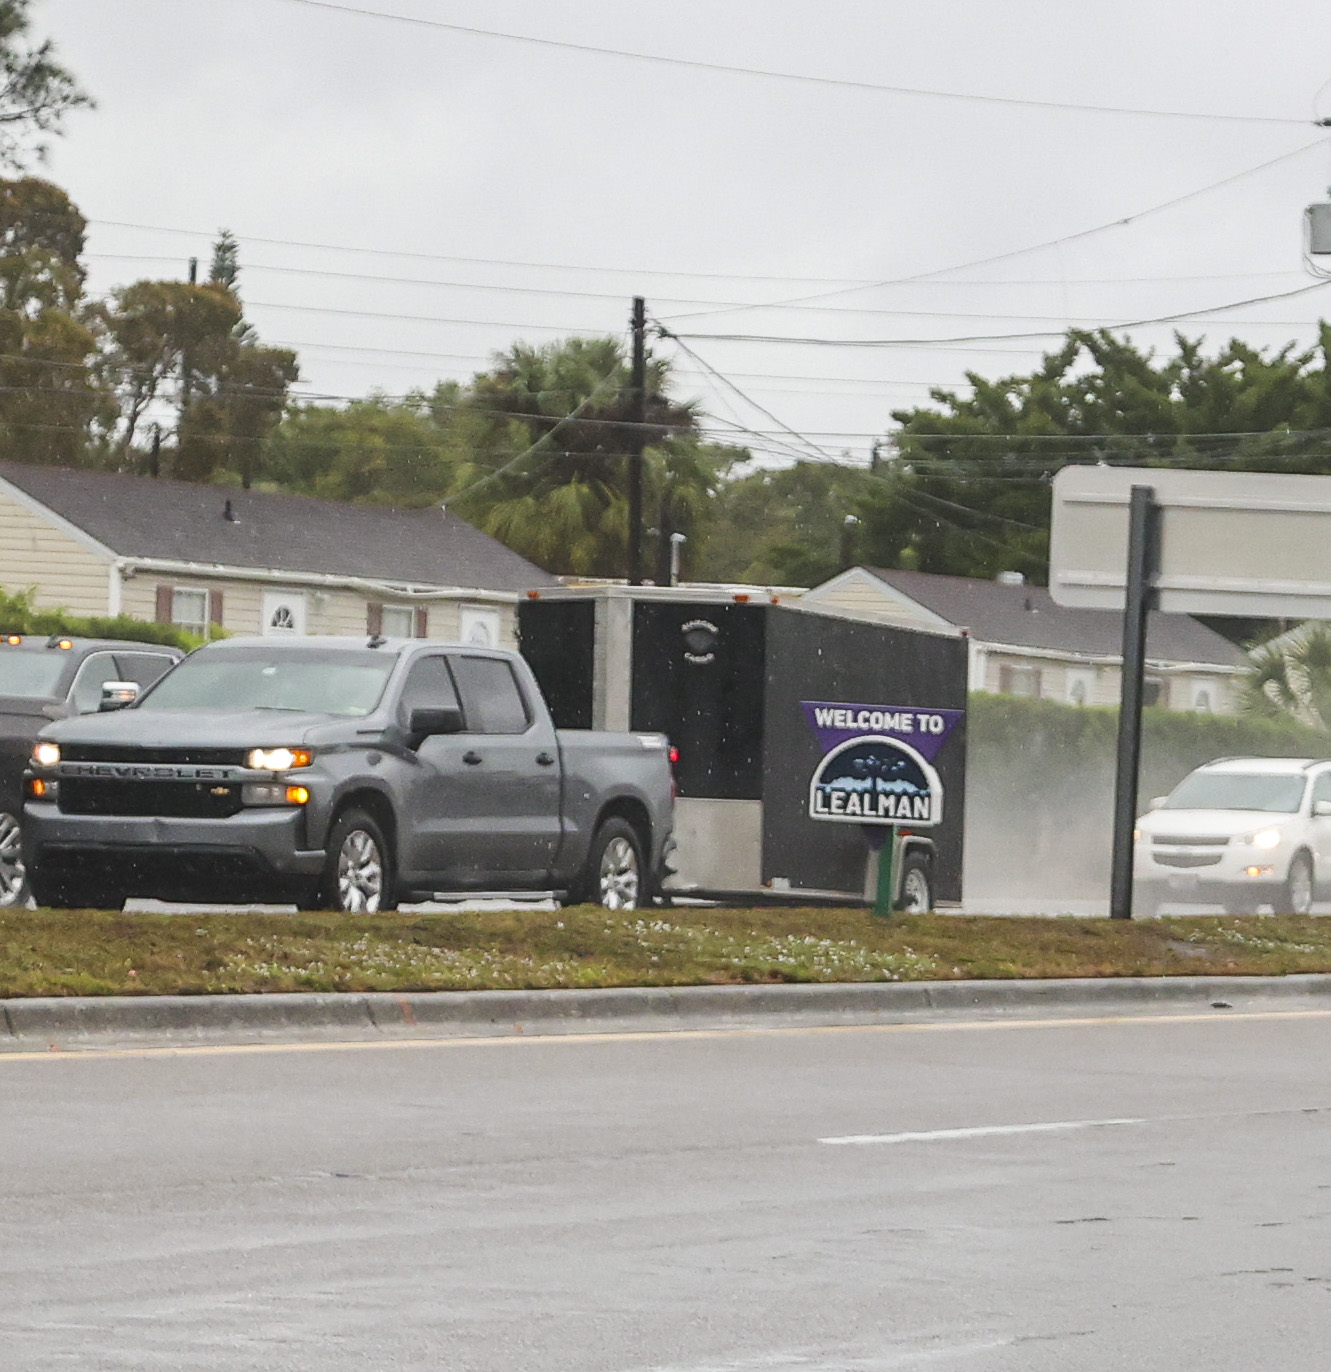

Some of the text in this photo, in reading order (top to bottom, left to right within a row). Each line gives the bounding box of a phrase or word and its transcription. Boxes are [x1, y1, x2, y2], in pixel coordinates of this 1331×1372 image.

[815, 708, 945, 735] WELCOME TO
[61, 765, 236, 779] CHEVROLET
[816, 789, 929, 819] LEALMAN
